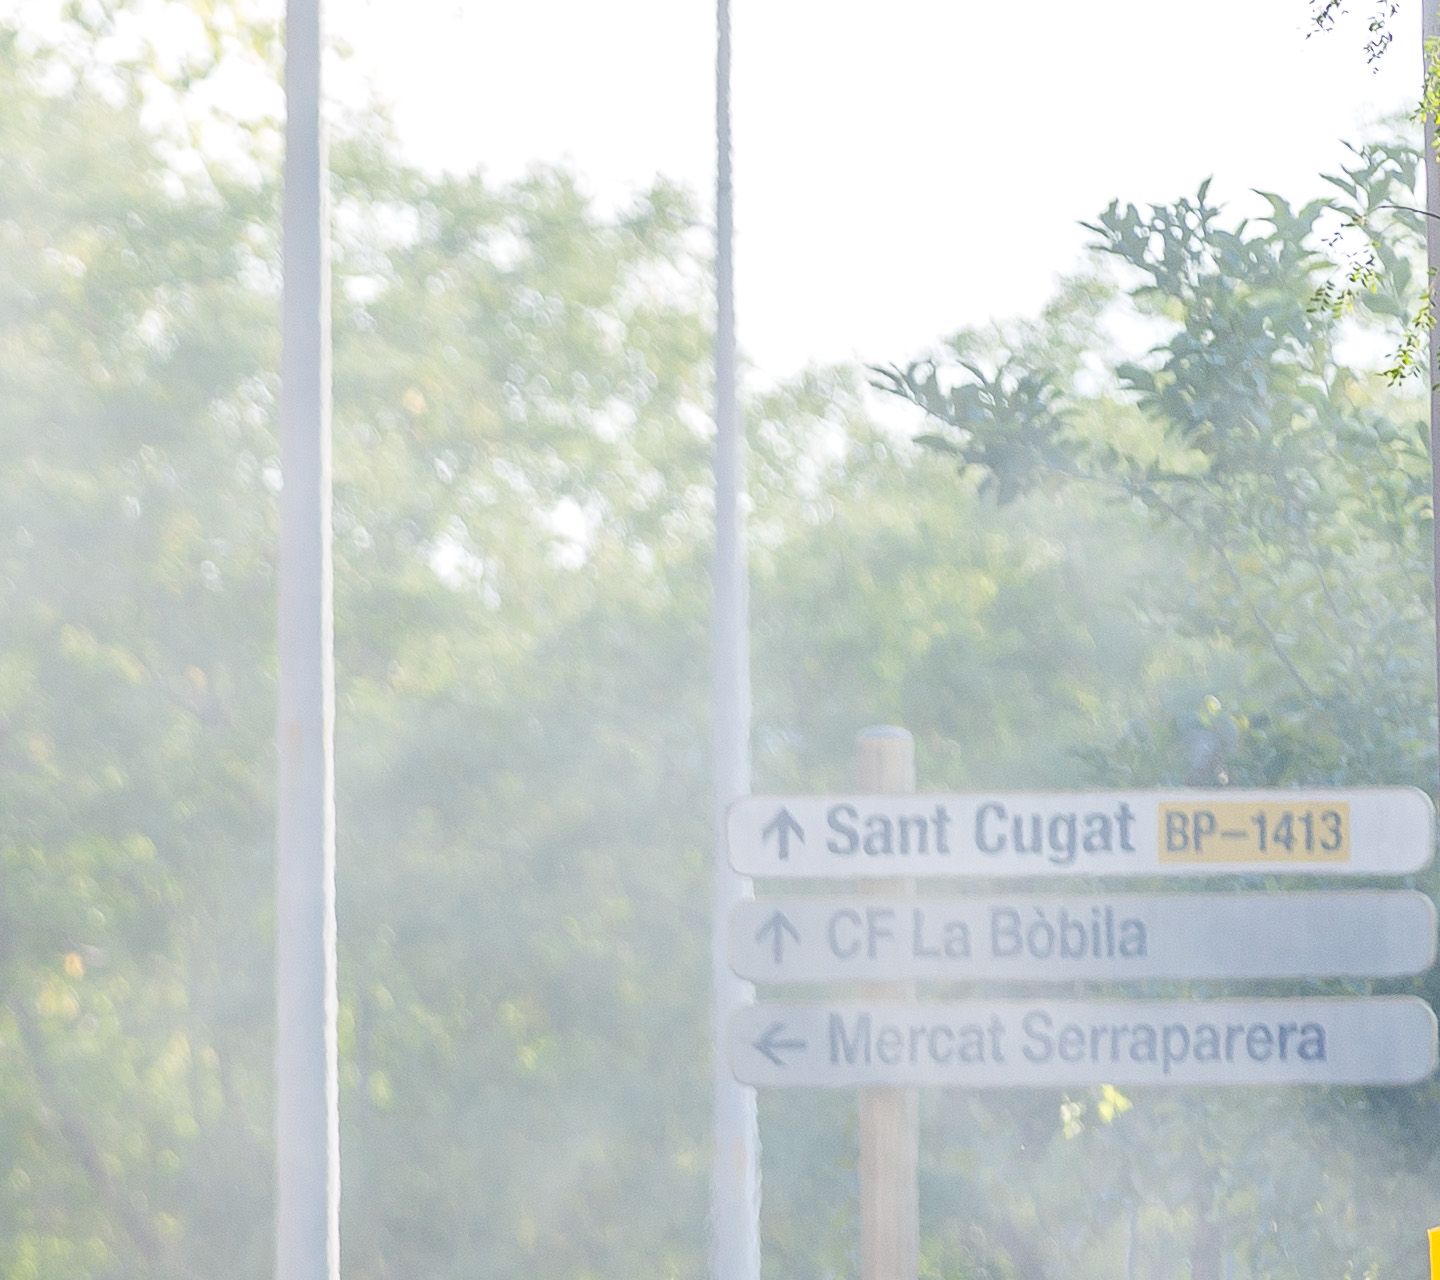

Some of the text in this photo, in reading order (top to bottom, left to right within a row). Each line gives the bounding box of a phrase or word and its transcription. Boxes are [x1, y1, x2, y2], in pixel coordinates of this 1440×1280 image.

[825, 801, 1343, 865] Sant Cugat BP-1413
[828, 903, 1148, 959] CF La Bòbila
[828, 1007, 1328, 1075] Mercat Serraparera
